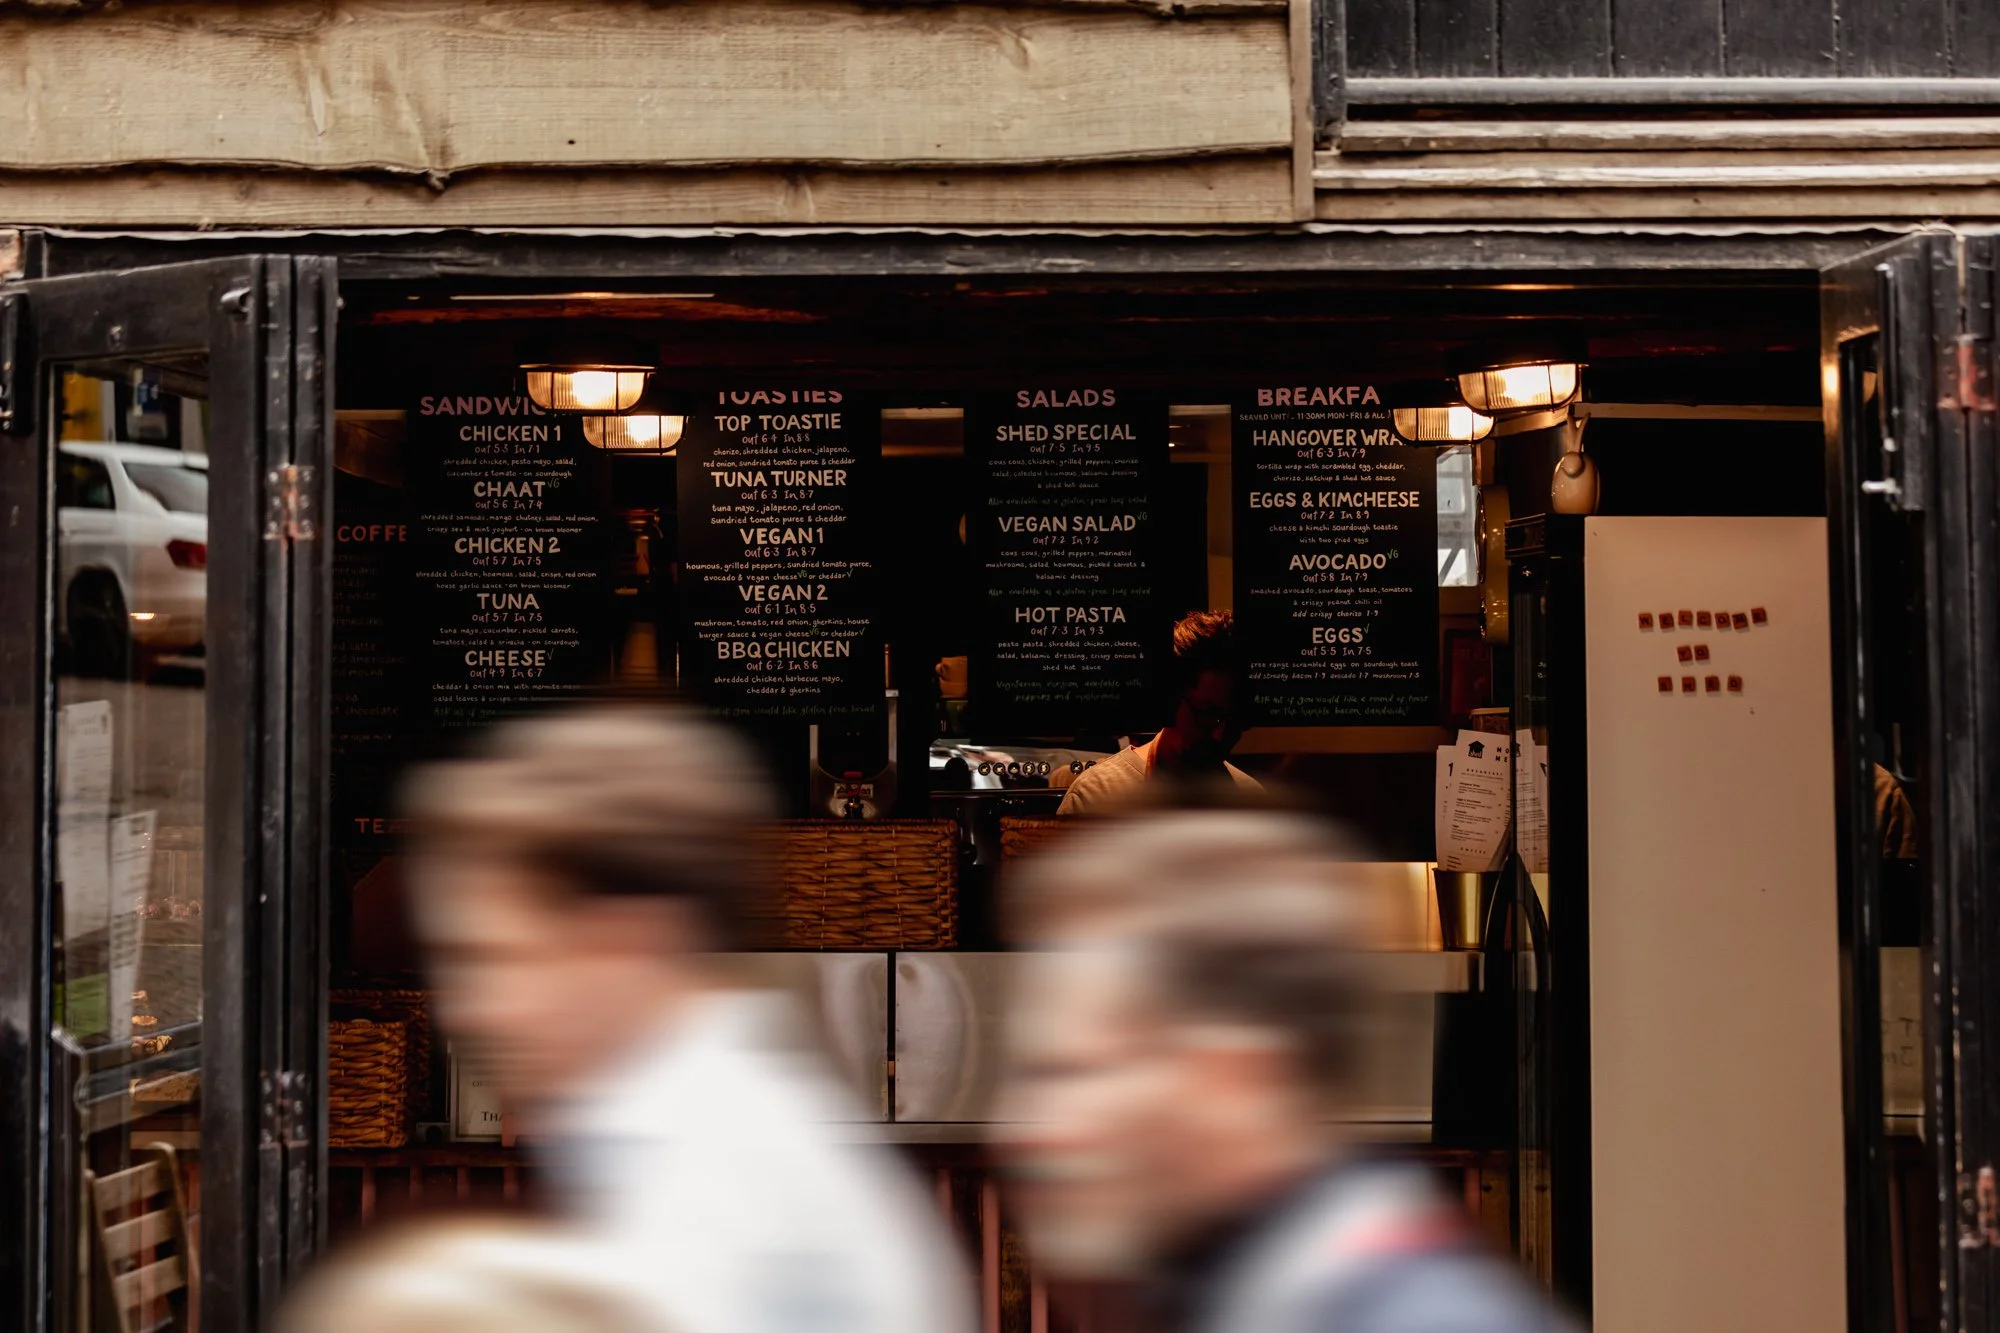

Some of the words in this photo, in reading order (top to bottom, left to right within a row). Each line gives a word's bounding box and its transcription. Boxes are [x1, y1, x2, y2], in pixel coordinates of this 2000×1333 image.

[719, 391, 842, 405] TOASTIES
[1017, 389, 1115, 408] SALADS
[714, 415, 751, 431] TOP
[759, 413, 841, 430] TOASTIE
[1240, 413, 1269, 421] SERVED
[1363, 411, 1371, 420] &
[1372, 411, 1386, 420] ALL
[460, 425, 547, 441] CHICKEN
[554, 425, 560, 441] 1
[996, 425, 1048, 441] SHED
[1053, 424, 1136, 440] SPECIAL
[1254, 429, 1356, 446] HANGOVER
[1361, 428, 1407, 446] WRA
[743, 446, 778, 456] shredded
[703, 459, 715, 468] red
[739, 458, 771, 467] sundried
[773, 458, 797, 466] tomato
[828, 457, 855, 465] cheddar
[1304, 462, 1320, 470] with
[1322, 462, 1356, 470] scrambled
[711, 471, 767, 487] TUNA
[771, 470, 846, 486] TURNER
[474, 481, 545, 497] CHAAT
[712, 503, 732, 513] tuna
[802, 502, 816, 512] red
[1250, 492, 1296, 508] EGGS
[1302, 492, 1314, 508] &
[1319, 491, 1419, 507] KIMCHEESE
[711, 515, 746, 525] sundried
[750, 515, 780, 524] tomato
[783, 516, 804, 526] puree
[815, 514, 846, 523] cheddar
[998, 516, 1067, 532] VEGAN
[1072, 515, 1136, 531] SALAD
[740, 528, 812, 544] VEGAN
[817, 528, 823, 543] 1
[1270, 524, 1297, 532] cheese
[1332, 523, 1370, 534] sourdough
[1373, 523, 1398, 531] toastie
[455, 537, 543, 553] CHICKEN
[549, 537, 560, 553] 2
[724, 561, 749, 573] grilled
[787, 560, 819, 569] sundried
[822, 560, 847, 568] tomato
[1289, 554, 1386, 570] AVOCADO
[704, 573, 735, 582] avocado
[747, 574, 769, 584] vegan
[773, 572, 797, 581] cheese
[819, 572, 846, 580] cheddar
[739, 585, 811, 601] VEGAN
[817, 584, 828, 600] 2
[477, 593, 539, 609] TUNA
[1016, 607, 1060, 623] HOT
[1067, 607, 1126, 623] PASTA
[1310, 610, 1332, 620] crispy
[1313, 627, 1363, 643] EGGS
[465, 650, 545, 666] CHEESE
[718, 642, 762, 659] BBQ
[765, 641, 849, 658] CHICKEN
[715, 675, 749, 684] shredded
[786, 675, 818, 683] barbecue
[747, 686, 778, 694] cheddar
[790, 686, 820, 697] gherkins
